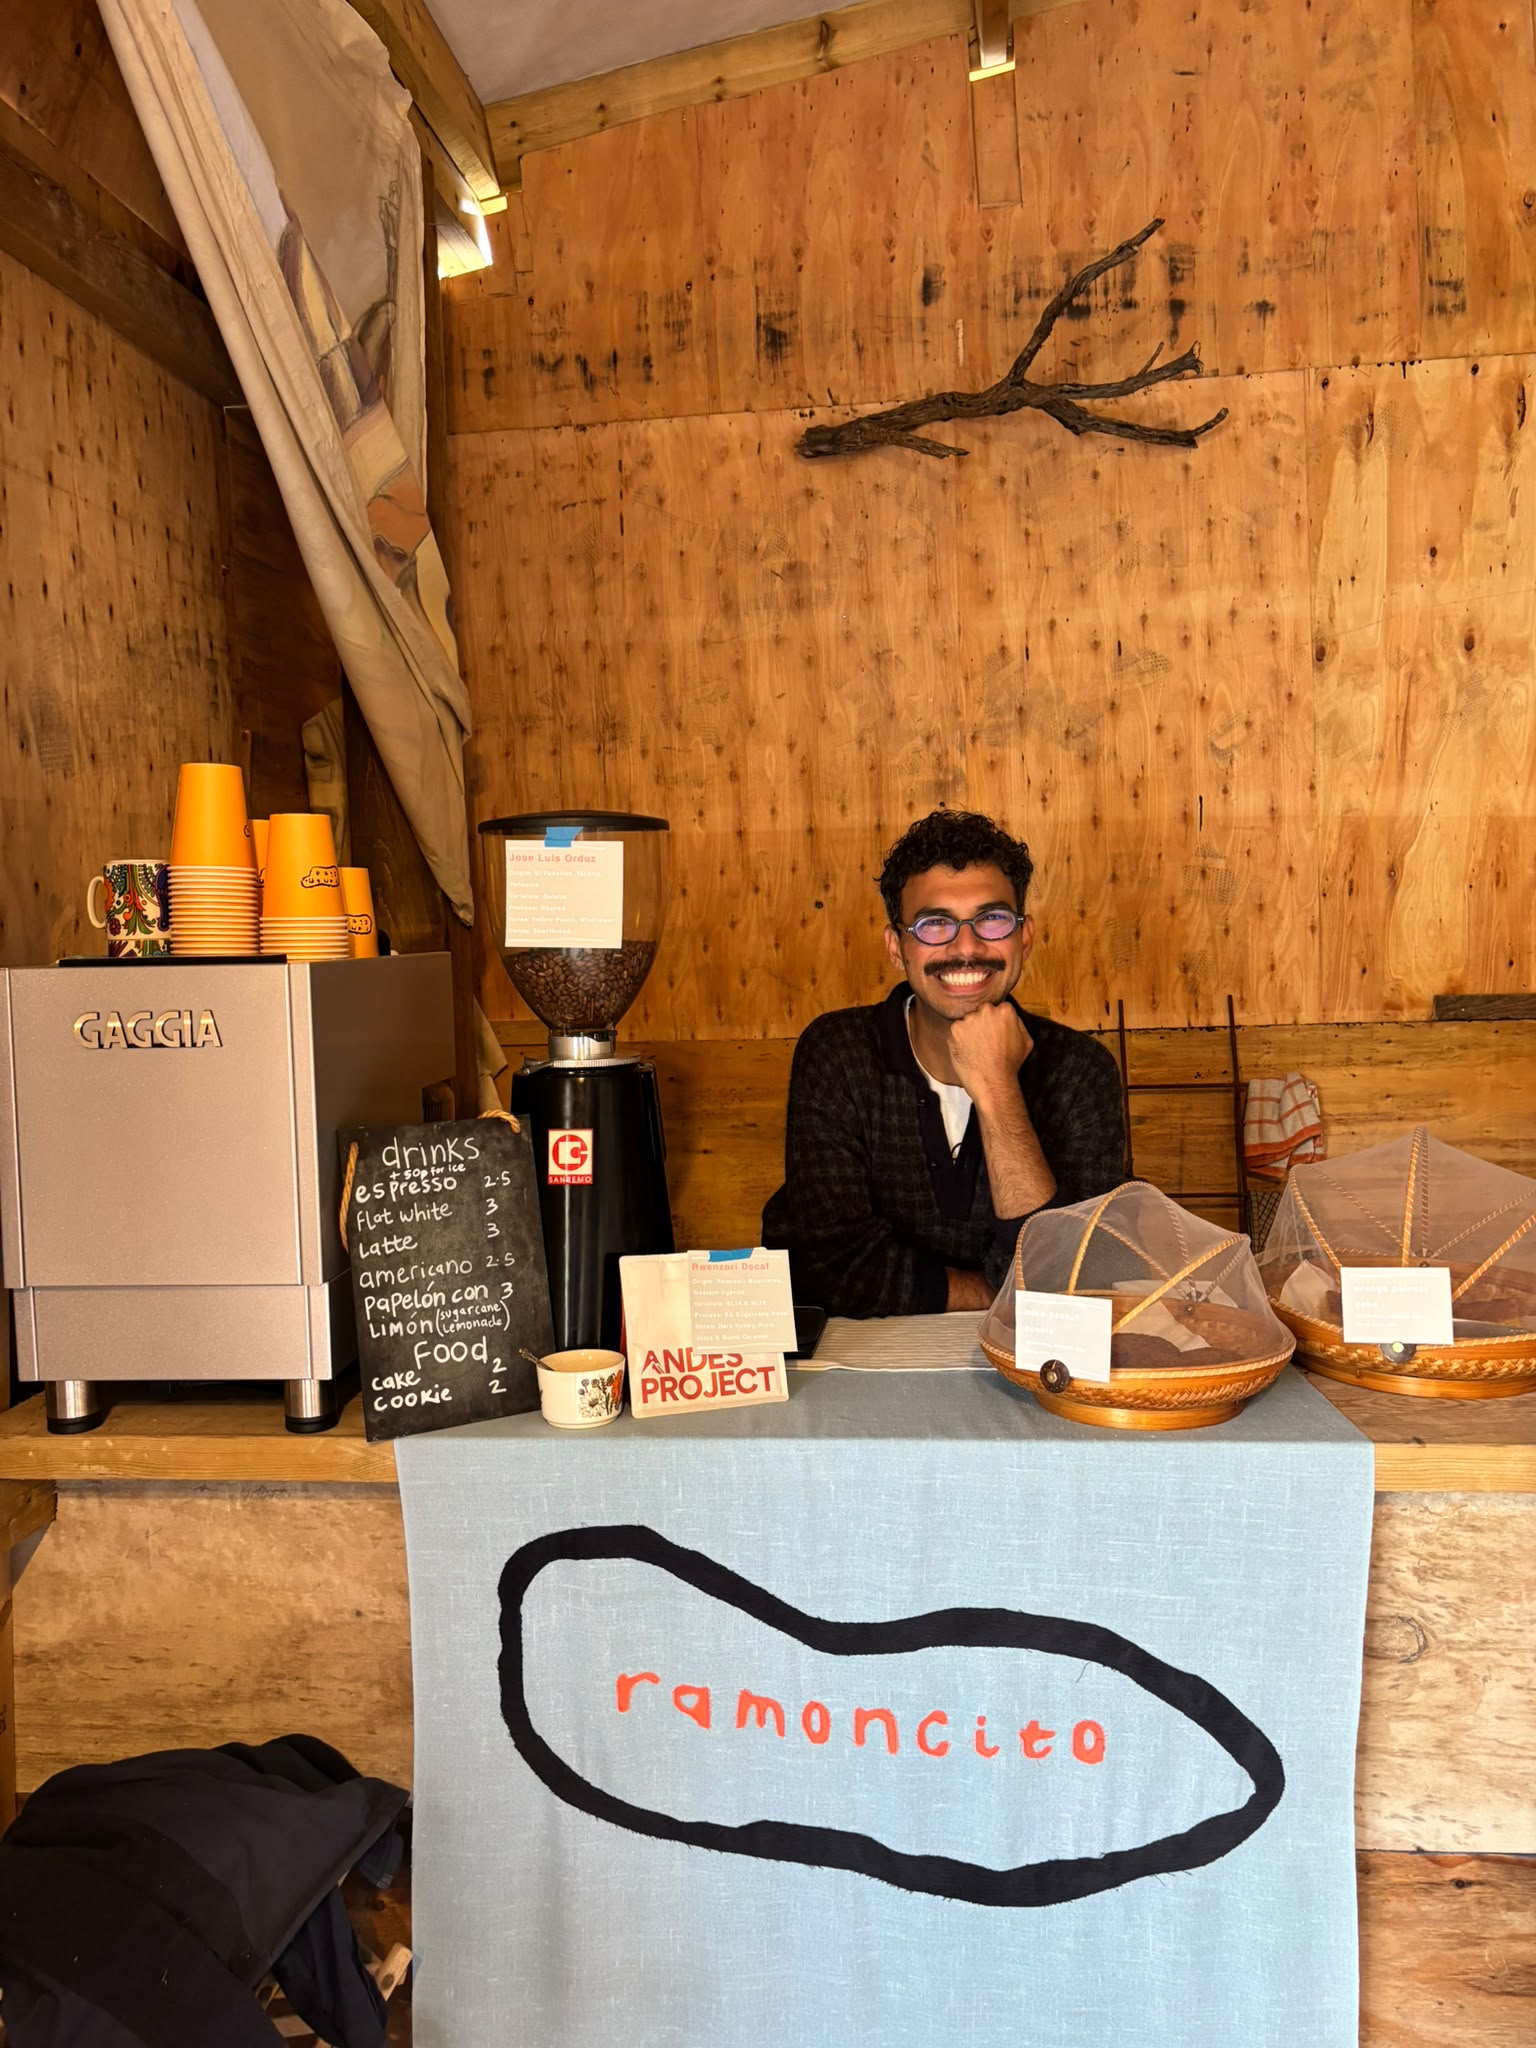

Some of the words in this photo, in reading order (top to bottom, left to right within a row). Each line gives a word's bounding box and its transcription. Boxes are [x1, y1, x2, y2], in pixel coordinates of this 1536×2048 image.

[509, 854, 534, 862] Jose
[538, 854, 561, 862] Luis
[564, 854, 597, 863] Orduz
[73, 1009, 222, 1049] GAGGIA
[430, 1166, 445, 1176] for
[448, 1163, 466, 1172] ice
[355, 1176, 458, 1204] espresso
[399, 1201, 453, 1223] white
[486, 1198, 499, 1216] 3
[487, 1222, 501, 1238] 3
[359, 1259, 473, 1288] americano
[691, 1262, 738, 1271] Rwenzori
[741, 1262, 770, 1271] Decaf
[451, 1284, 489, 1304] con
[500, 1281, 514, 1300] 3
[371, 1370, 421, 1391] cake
[492, 1357, 508, 1373] 2
[641, 1347, 743, 1375] ANDES
[373, 1383, 453, 1412] cookie
[488, 1379, 508, 1394] 2
[641, 1366, 775, 1404] PROJECT
[616, 1672, 1106, 1764] ramoncito
